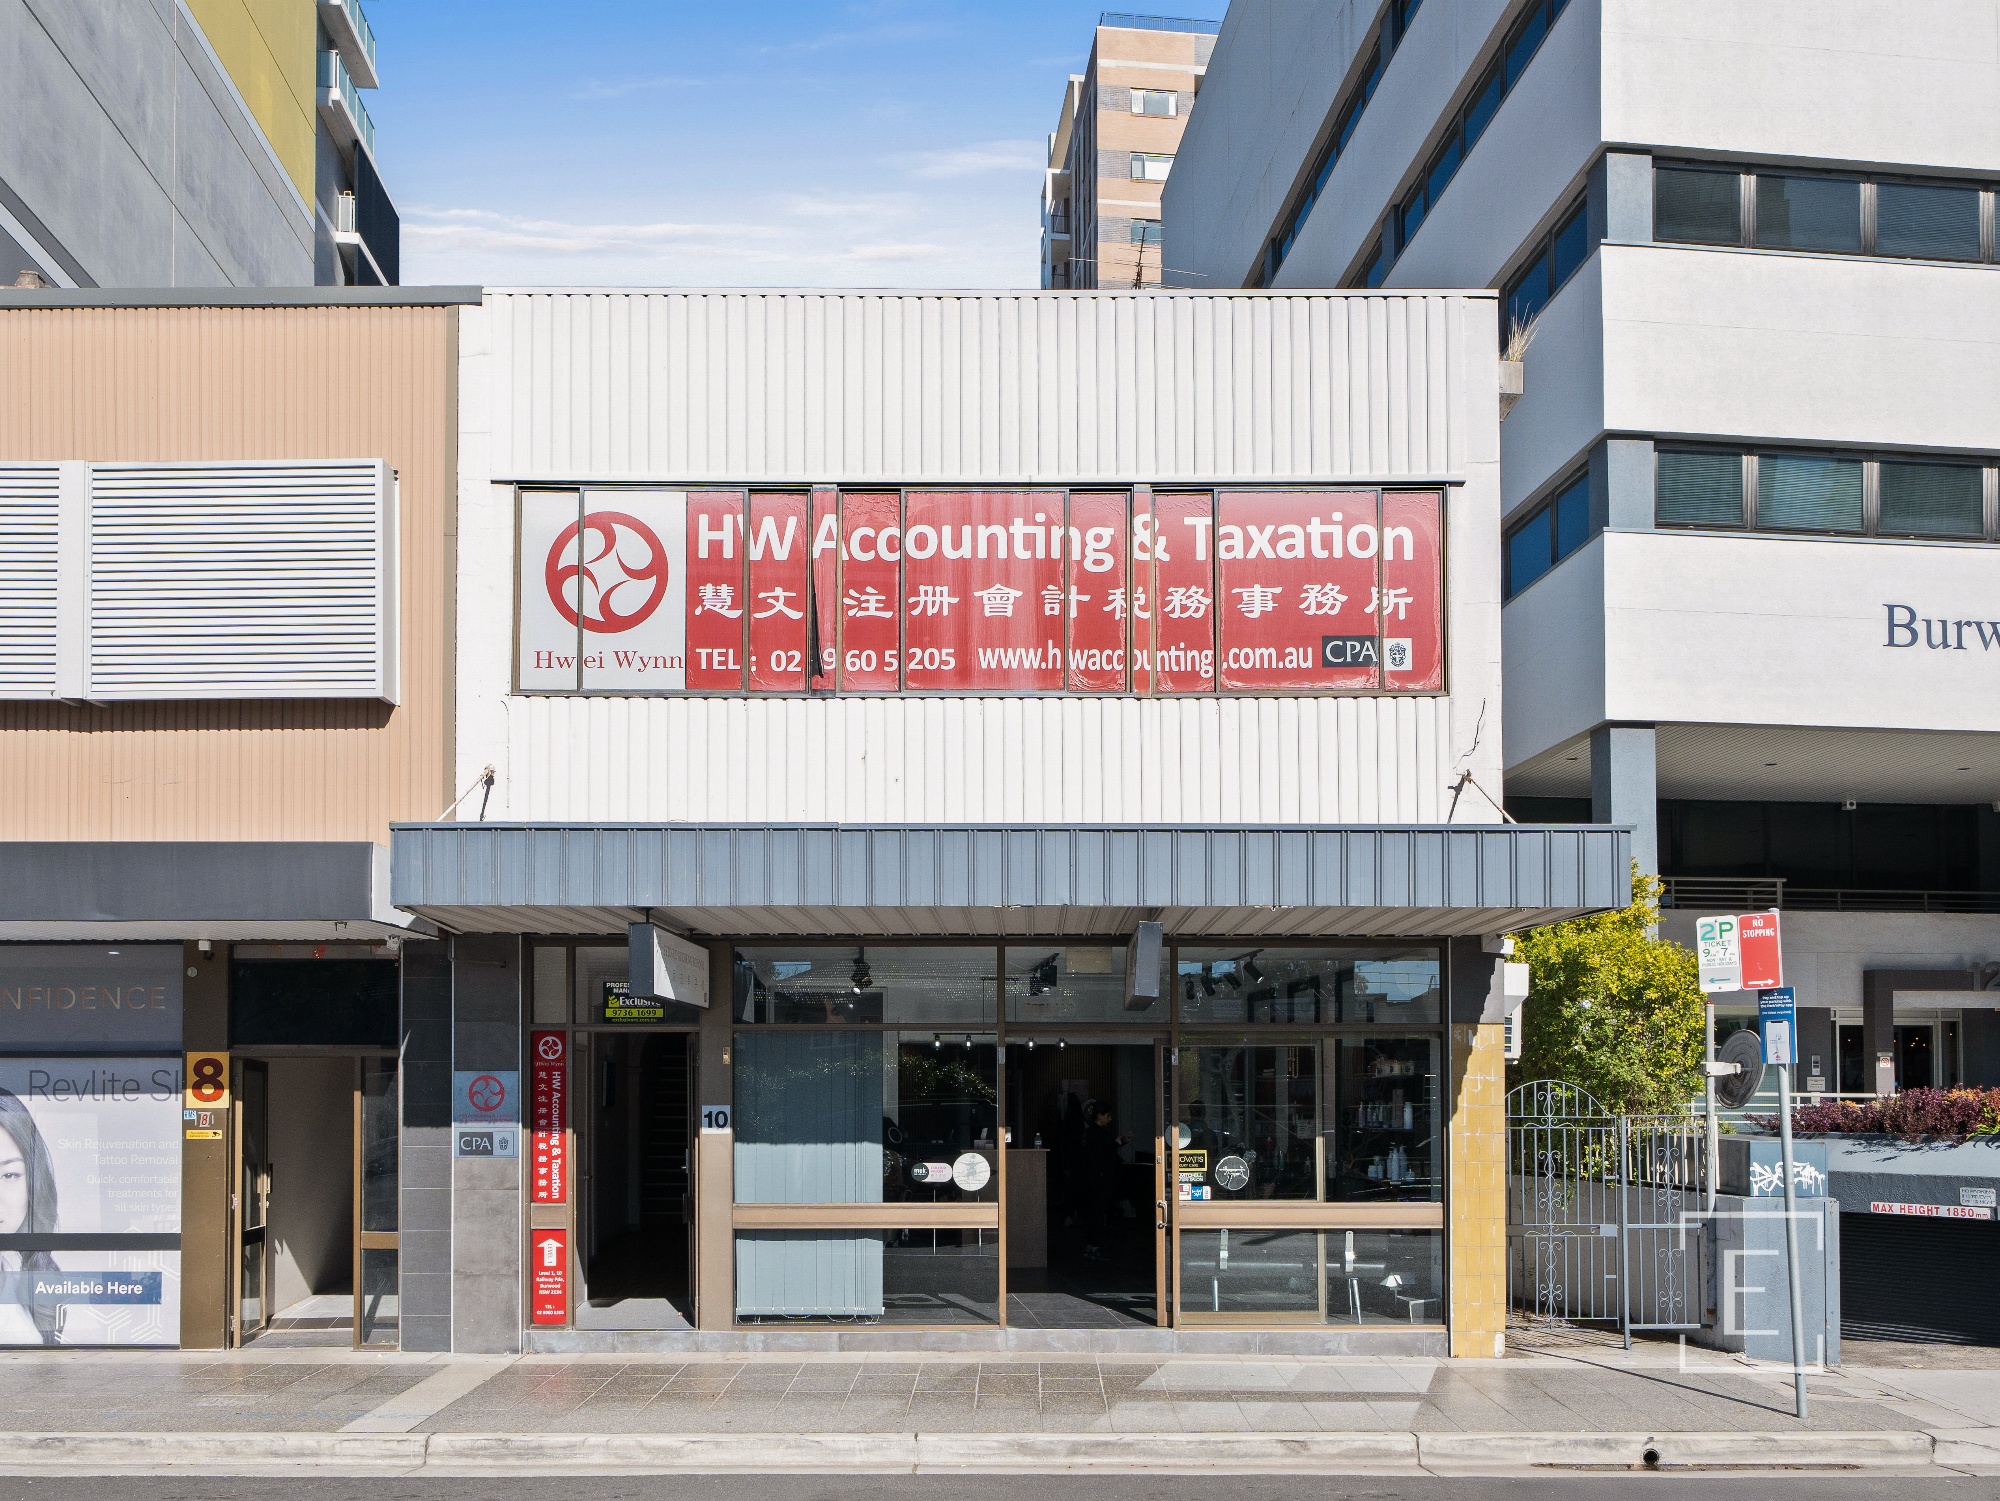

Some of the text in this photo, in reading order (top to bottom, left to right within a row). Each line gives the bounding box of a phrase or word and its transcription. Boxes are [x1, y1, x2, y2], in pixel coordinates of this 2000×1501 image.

[698, 512, 1413, 573] HW Accounting & Taxation
[1882, 603, 2000, 651] Burw
[1325, 641, 1378, 663] CPA
[534, 650, 684, 673] Hwei Wynn
[771, 649, 802, 672] 02
[1752, 918, 1764, 928] NO
[1700, 921, 1734, 941] 2P
[1742, 928, 1775, 938] STOPPING
[29, 1069, 140, 1102] Revlite
[192, 1058, 224, 1102] 8
[201, 1114, 208, 1125] 8
[704, 1111, 728, 1129] 10
[550, 1071, 561, 1199] HW Accounting & Taxation
[58, 1139, 179, 1151] Skin Rejuvenation and
[460, 1137, 491, 1150] CPA
[93, 1155, 179, 1165] Tattoo Removal
[87, 1174, 179, 1185] Quick, comfortable
[108, 1188, 179, 1198] treatments for
[115, 1203, 179, 1214] all skin types
[1872, 1203, 1894, 1213] MAX
[1900, 1205, 1940, 1216] HEIGHT
[35, 1281, 143, 1294] Available Here
